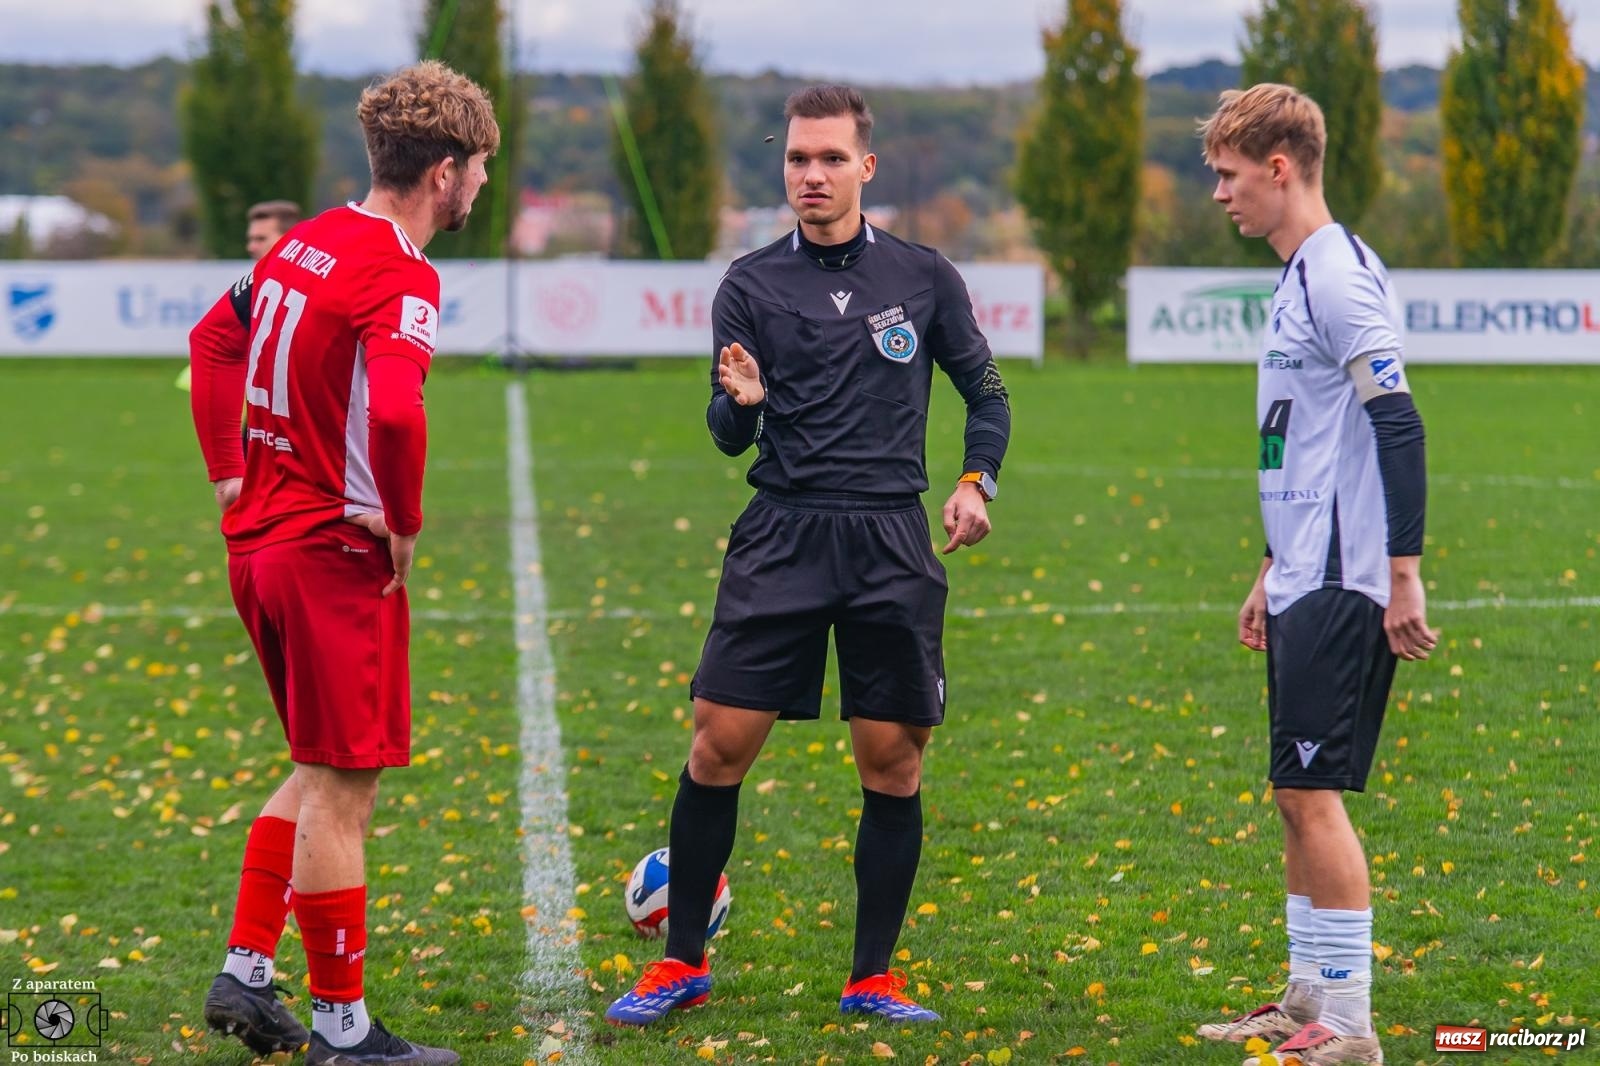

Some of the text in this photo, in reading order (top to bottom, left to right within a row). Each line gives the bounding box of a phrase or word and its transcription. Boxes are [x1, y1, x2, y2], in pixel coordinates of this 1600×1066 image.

[296, 246, 338, 279] TURZA
[414, 306, 429, 325] 3
[868, 305, 904, 325] KOLEGIUM
[417, 326, 431, 338] LIGA
[246, 277, 308, 418] 21
